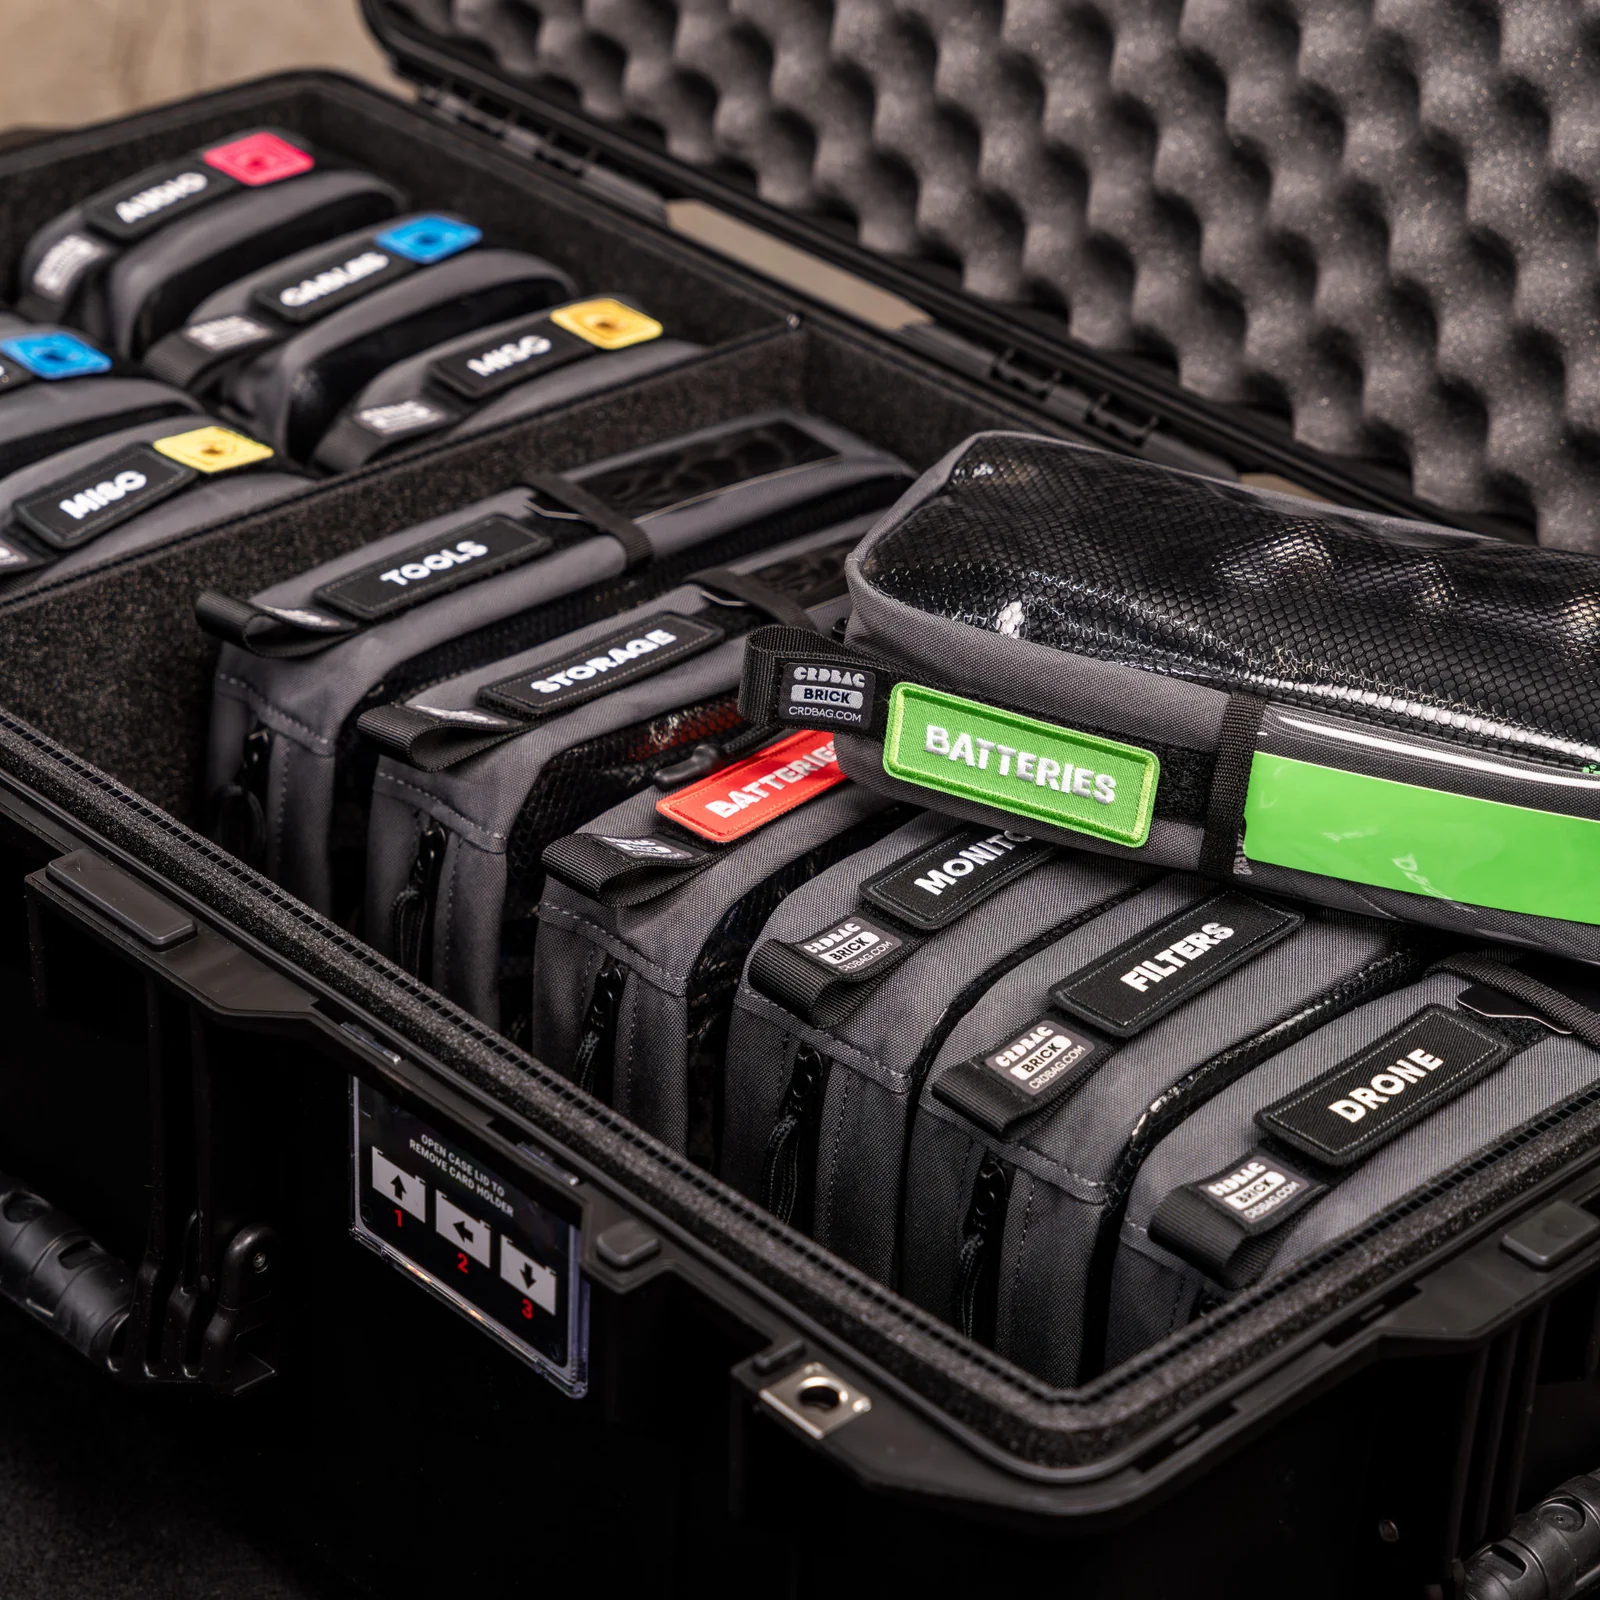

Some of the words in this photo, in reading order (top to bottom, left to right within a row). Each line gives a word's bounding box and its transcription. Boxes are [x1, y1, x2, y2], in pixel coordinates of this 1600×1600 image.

[380, 540, 488, 585] TOOLS
[530, 629, 677, 693] STORAGE
[788, 706, 861, 722] CRDBAG.COM
[803, 688, 850, 704] BRICK
[925, 724, 1116, 804] BATTERIES
[829, 937, 871, 961] BRICK
[1119, 922, 1234, 992] FILTERS
[1021, 1042, 1061, 1073] BRICK
[1028, 1045, 1086, 1089] CRDBAG.COM
[1327, 1048, 1444, 1123] DRONE
[409, 1138, 447, 1172] REMOVE
[449, 1166, 475, 1189] CARD
[476, 1184, 514, 1218] HOLDER
[421, 1134, 446, 1157] OPEN
[448, 1152, 473, 1175] CASE
[474, 1169, 490, 1186] LID
[491, 1181, 505, 1197] TO
[394, 1209, 403, 1228] 1
[457, 1252, 469, 1274] 2
[521, 1298, 533, 1319] 3
